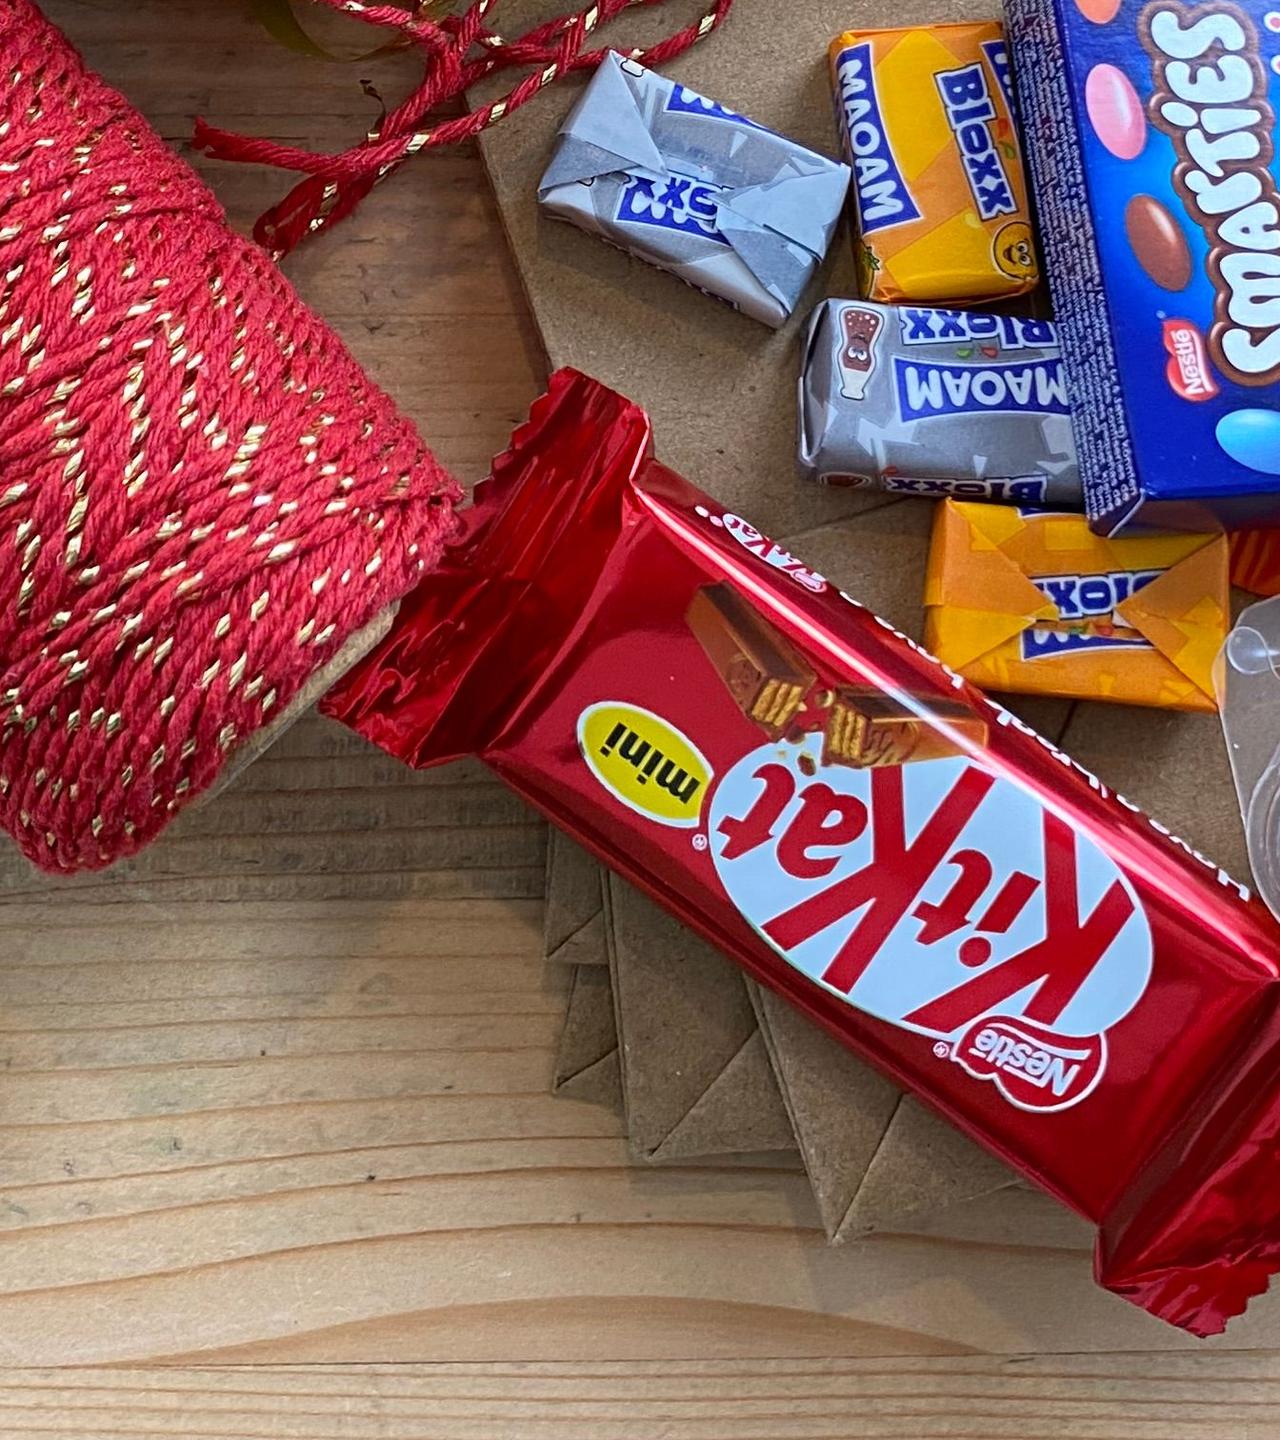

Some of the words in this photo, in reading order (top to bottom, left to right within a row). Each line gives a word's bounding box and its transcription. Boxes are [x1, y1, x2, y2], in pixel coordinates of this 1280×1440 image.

[837, 56, 905, 222] MAOAM
[939, 65, 1015, 219] Bloxx
[904, 365, 1068, 410] MAOAM
[599, 722, 702, 805] mini
